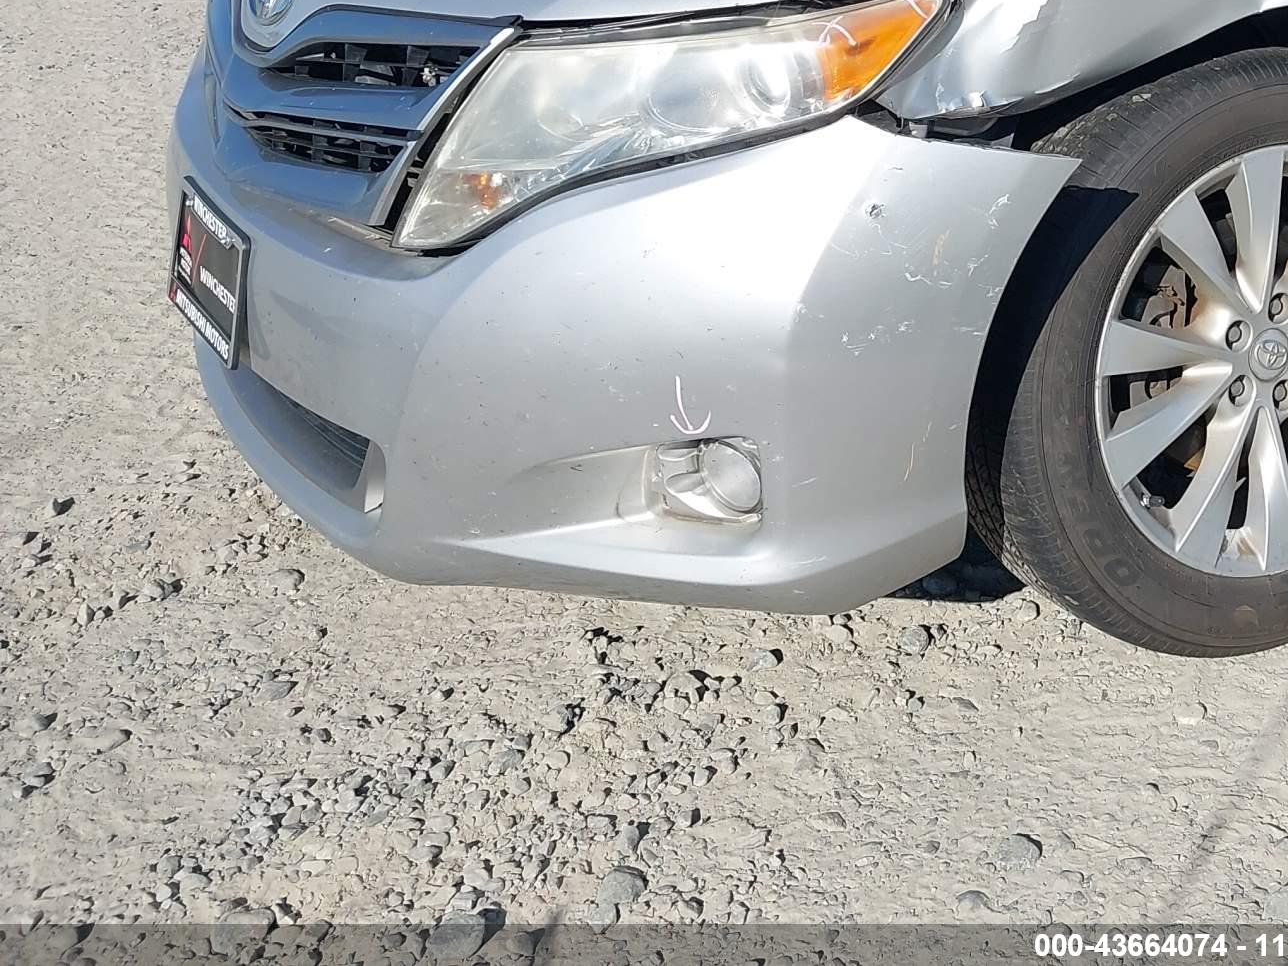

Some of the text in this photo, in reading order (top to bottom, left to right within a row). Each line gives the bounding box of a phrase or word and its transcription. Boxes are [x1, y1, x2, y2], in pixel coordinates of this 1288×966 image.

[199, 264, 236, 314] WINCHESTE
[175, 288, 207, 334] MITSUBISHI
[205, 321, 230, 360] MOTORS
